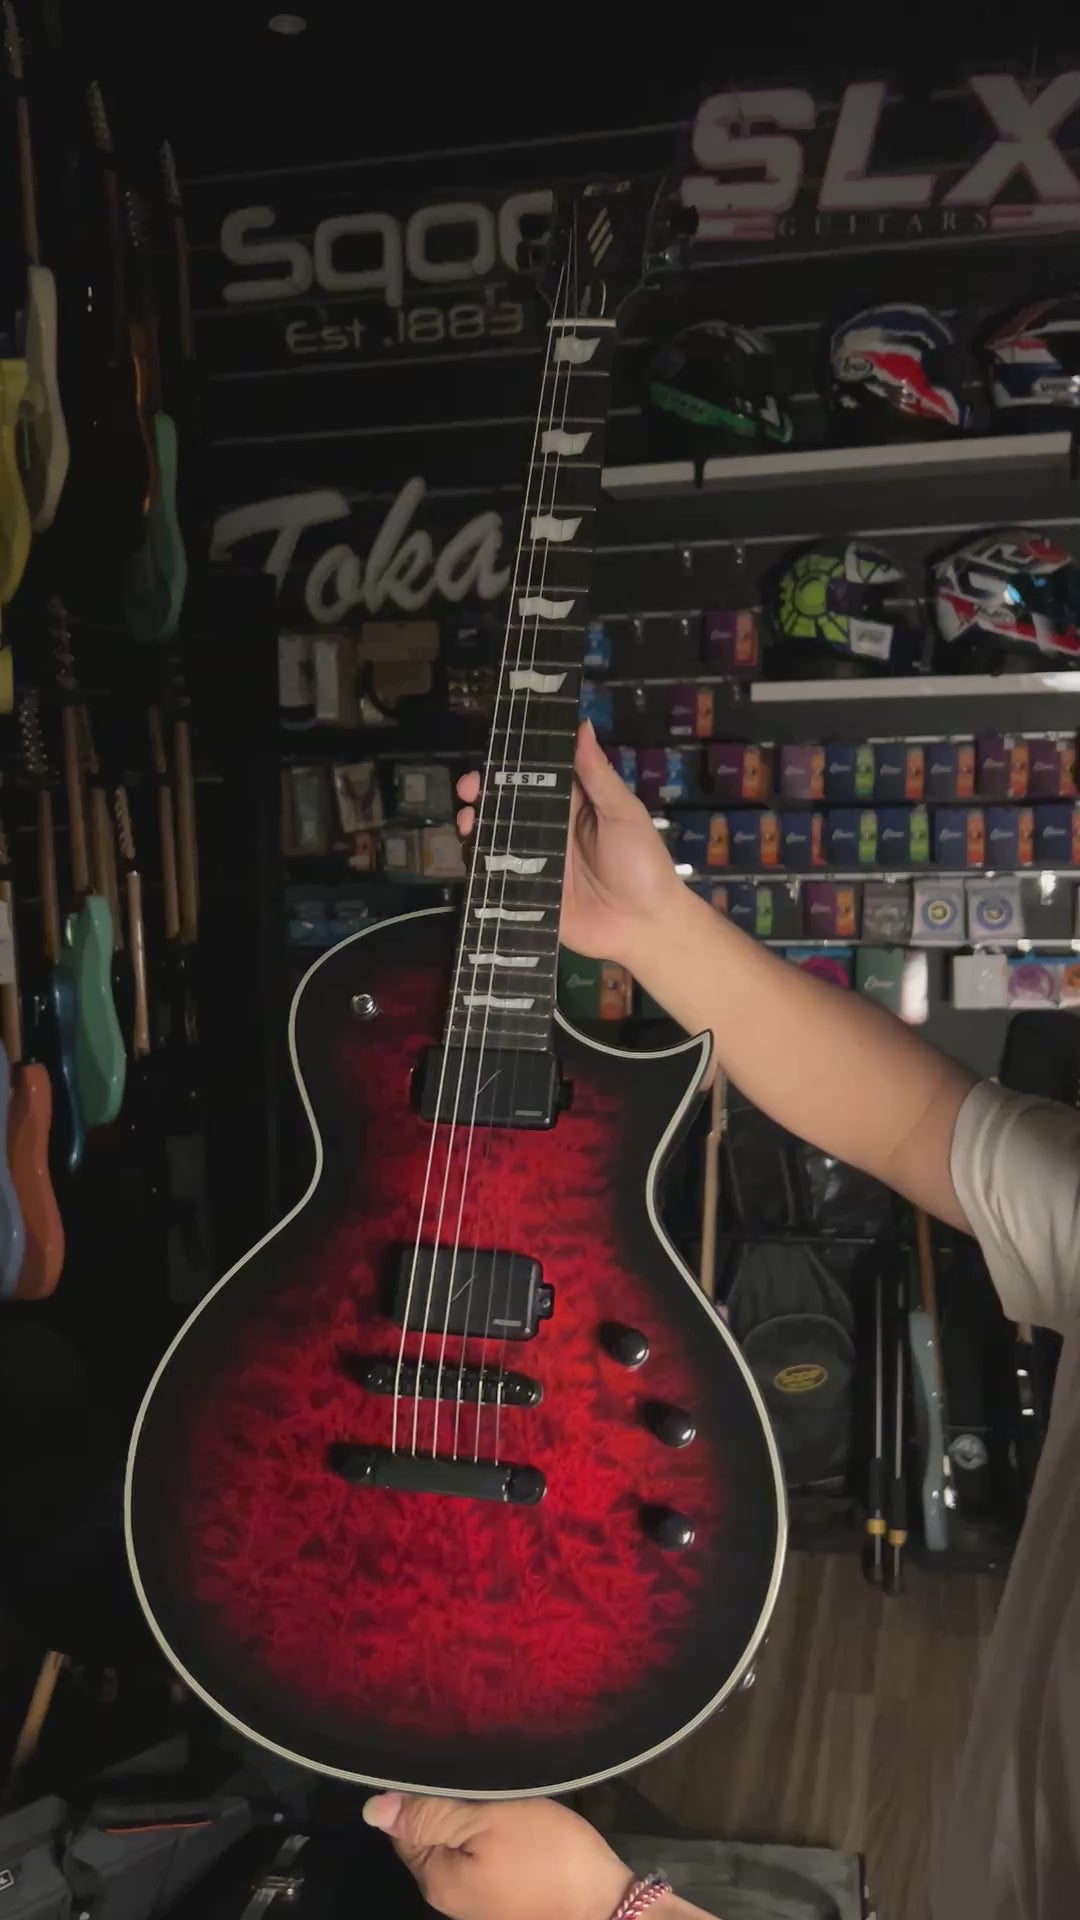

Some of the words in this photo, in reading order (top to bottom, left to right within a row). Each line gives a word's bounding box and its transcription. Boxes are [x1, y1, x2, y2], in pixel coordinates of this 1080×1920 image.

[680, 72, 1080, 212] SLX
[778, 208, 988, 236] GUITARS
[505, 772, 545, 785] ESP
